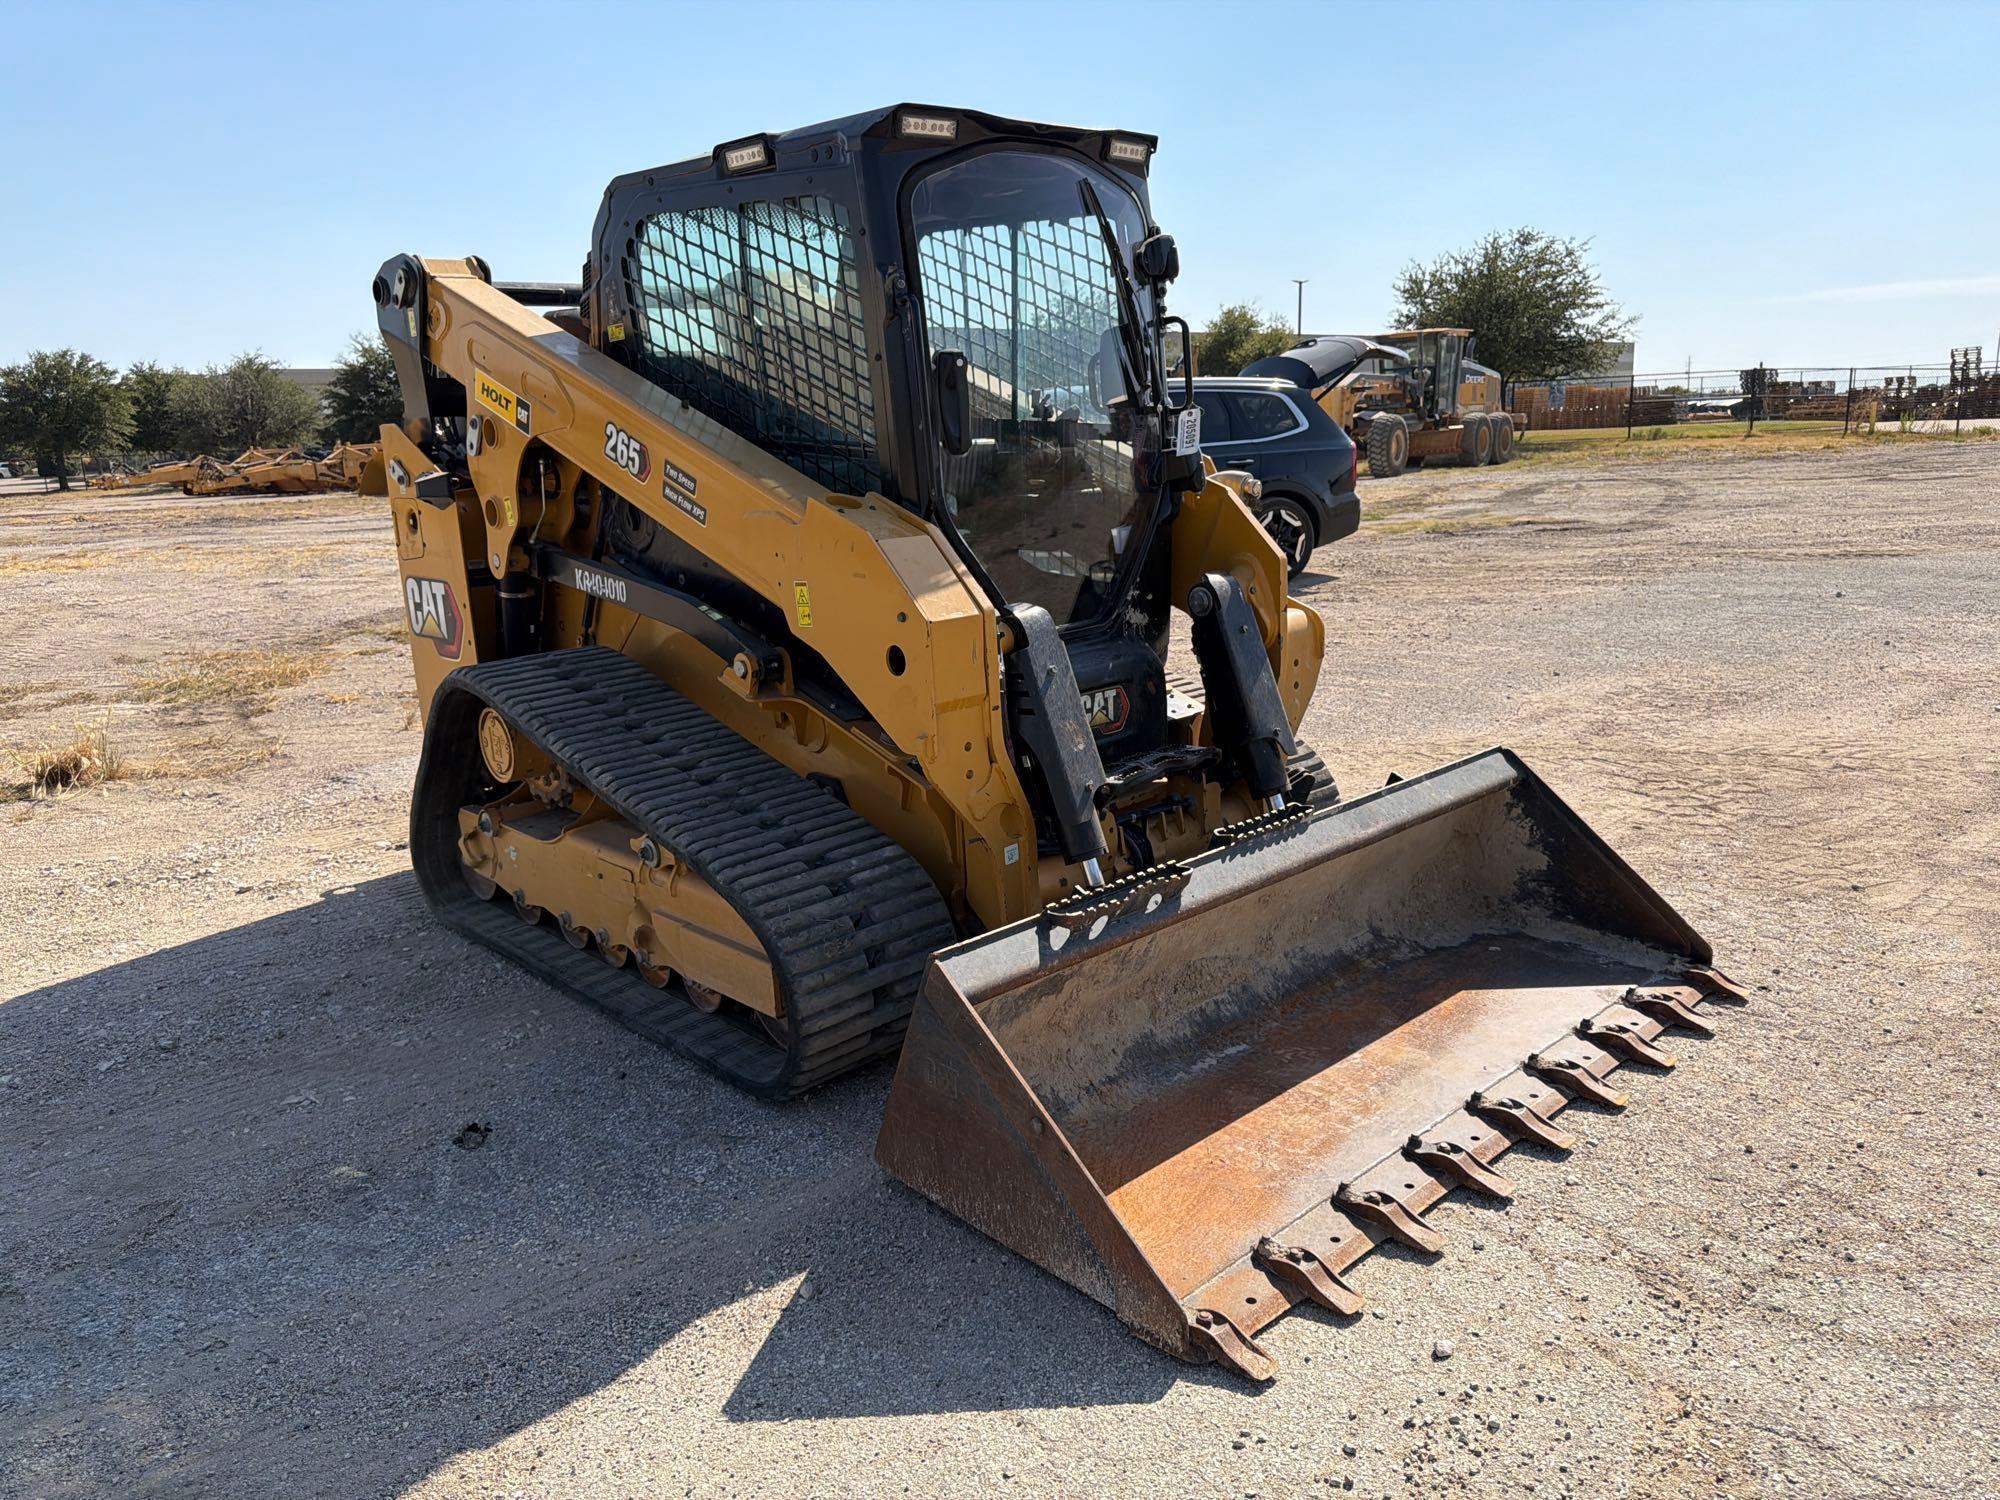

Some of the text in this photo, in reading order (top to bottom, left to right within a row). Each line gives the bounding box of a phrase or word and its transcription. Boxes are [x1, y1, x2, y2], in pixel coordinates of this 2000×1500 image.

[481, 382, 529, 425] HOLT CAT
[605, 422, 641, 475] 265
[692, 505, 705, 520] XPS
[406, 577, 448, 640] CAT
